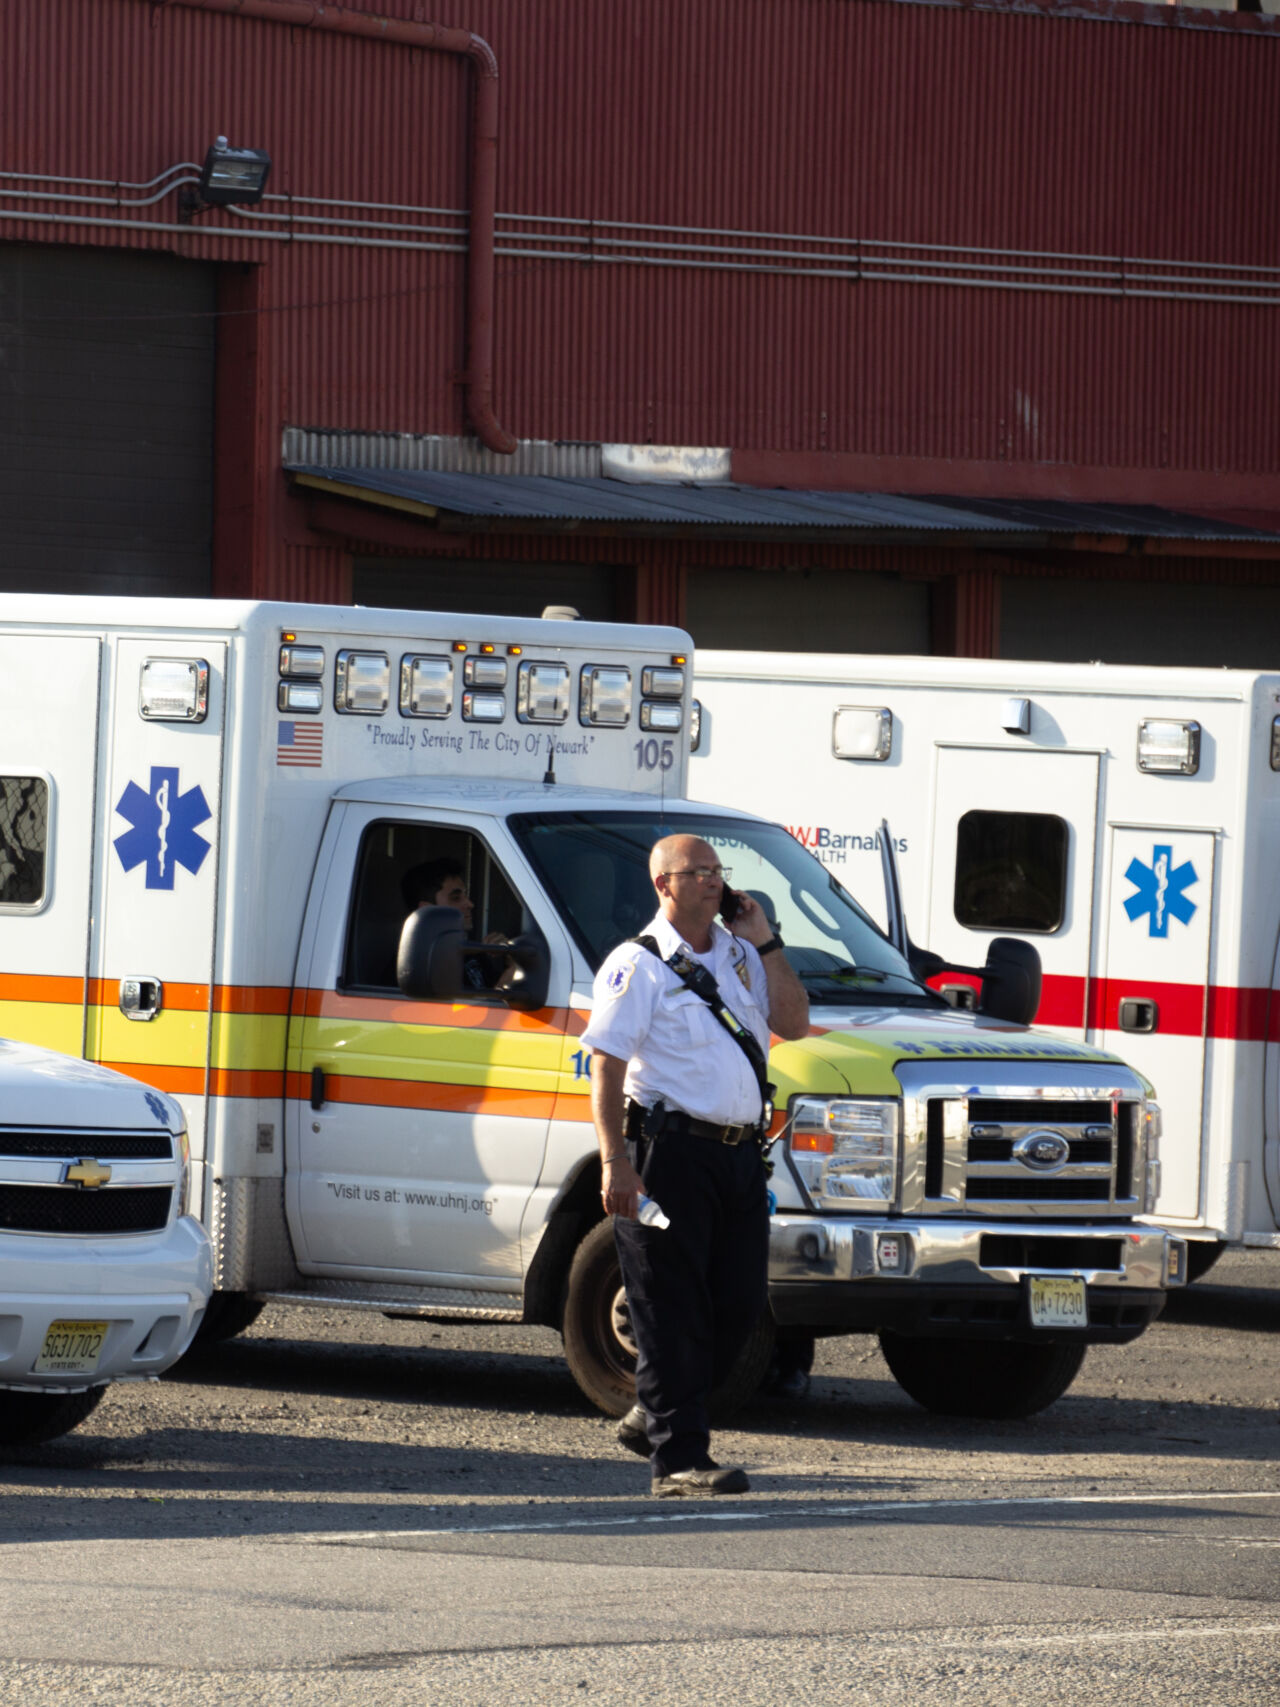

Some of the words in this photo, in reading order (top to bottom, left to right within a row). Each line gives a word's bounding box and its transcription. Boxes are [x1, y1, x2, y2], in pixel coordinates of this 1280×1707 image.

[367, 723, 416, 751] "Proudly
[420, 727, 463, 754] Serving
[469, 730, 490, 750] The
[495, 731, 519, 755] City
[524, 733, 542, 756] Of
[546, 734, 595, 755] Newark"
[634, 738, 674, 771] 105
[810, 849, 847, 864] ALTH
[327, 1182, 361, 1200] "Visit
[364, 1189, 380, 1202] us
[384, 1188, 401, 1203] at:
[42, 1334, 102, 1358] SG31702
